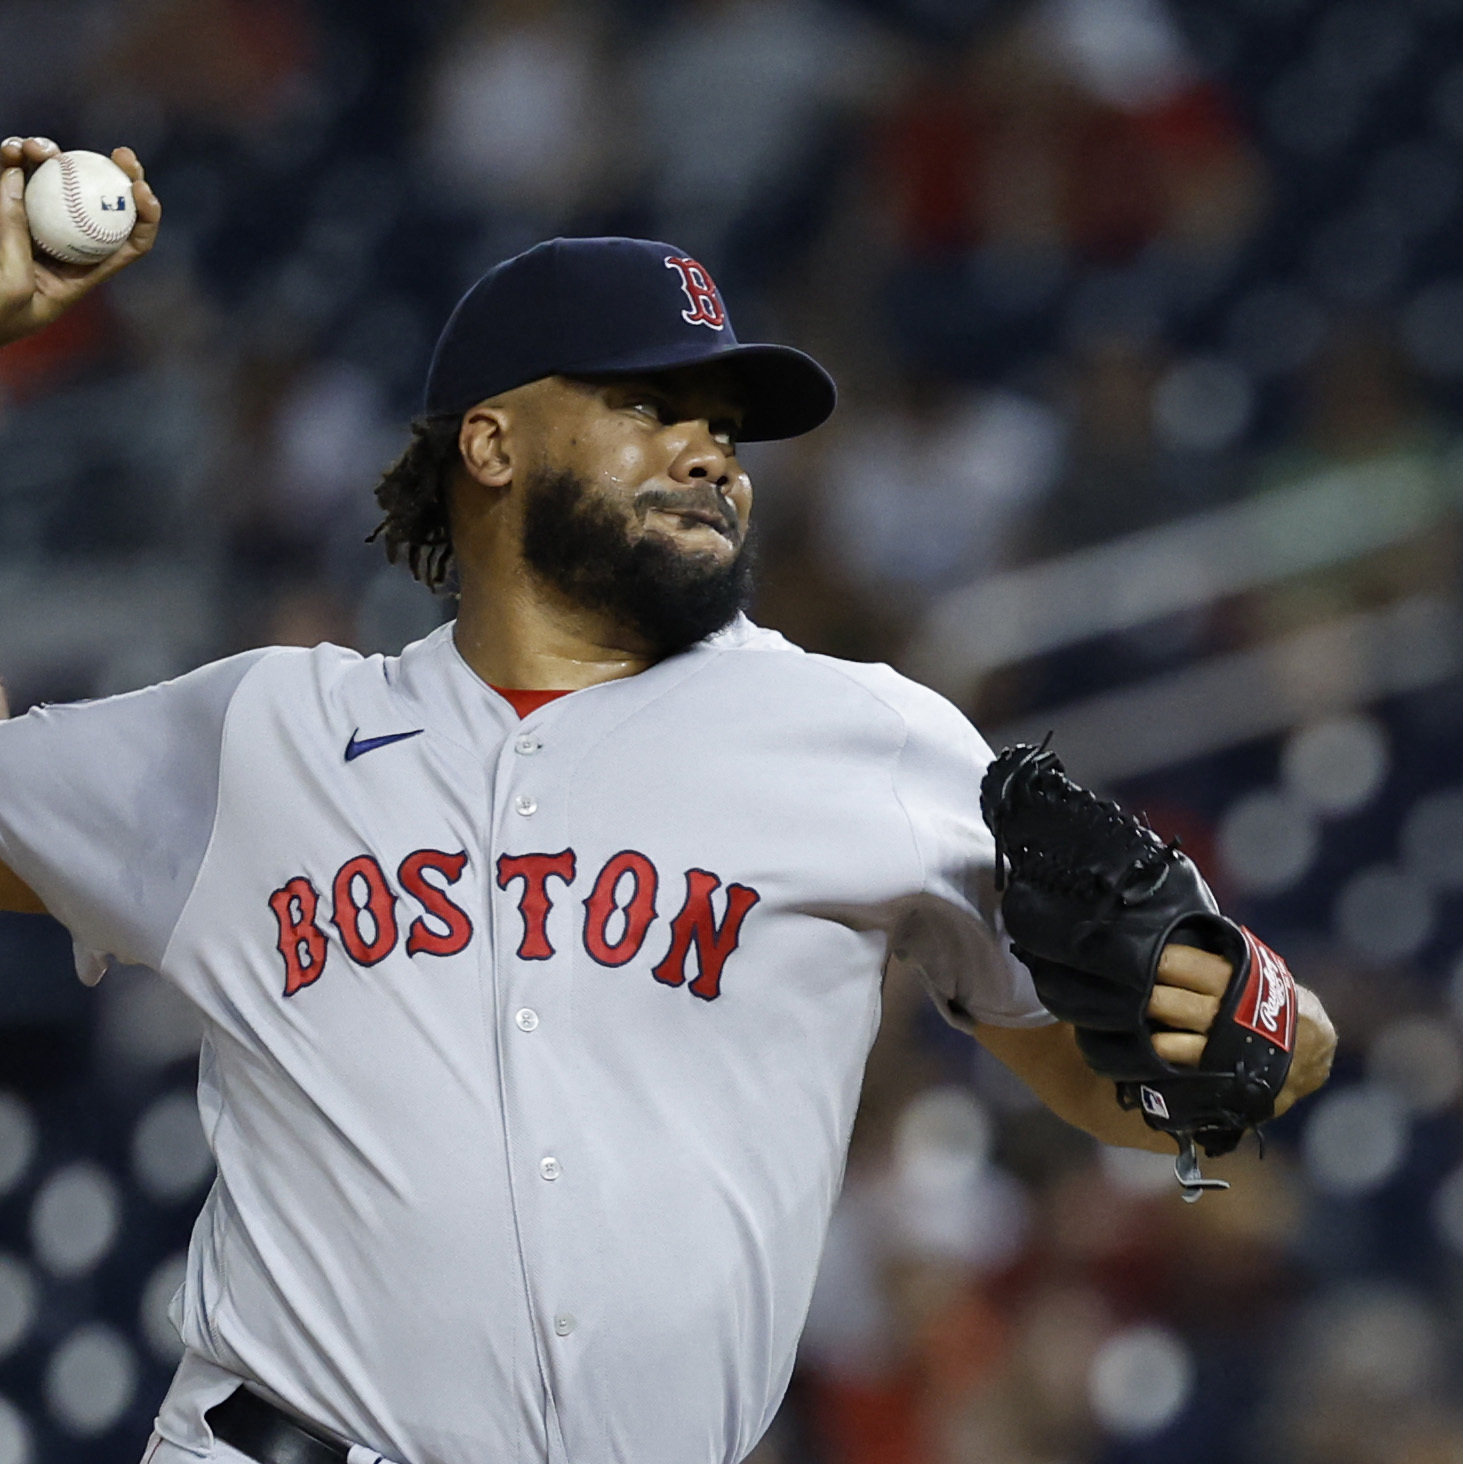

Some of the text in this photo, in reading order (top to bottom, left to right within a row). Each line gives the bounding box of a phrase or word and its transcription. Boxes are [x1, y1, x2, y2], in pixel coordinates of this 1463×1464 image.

[664, 255, 725, 331] B
[268, 848, 761, 1001] BOSTON
[1258, 945, 1287, 1032] Rawl
